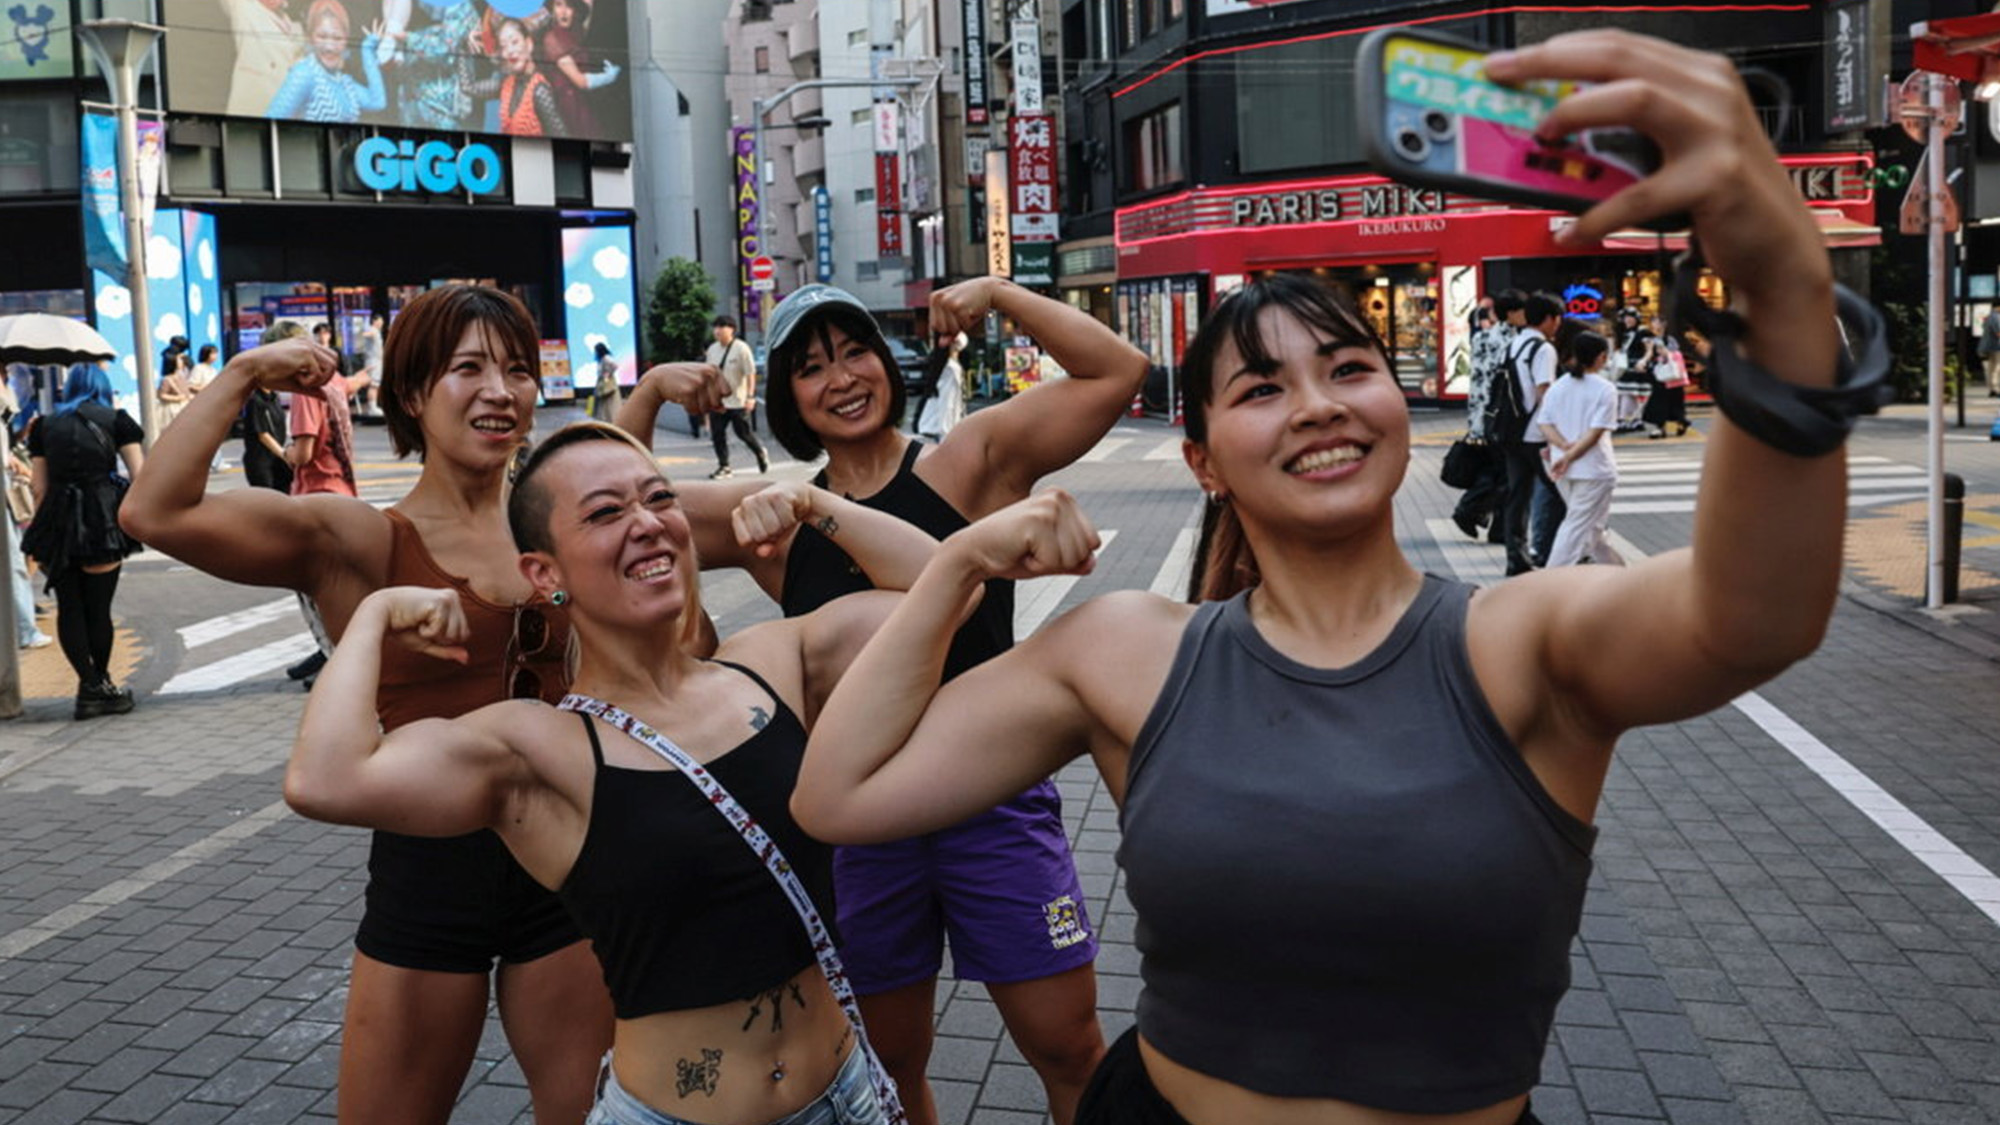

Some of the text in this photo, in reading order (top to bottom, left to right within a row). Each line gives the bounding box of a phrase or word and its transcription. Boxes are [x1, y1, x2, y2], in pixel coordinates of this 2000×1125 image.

[354, 136, 501, 195] GiGO
[1017, 182, 1052, 212] 肉
[1233, 190, 1339, 225] PARIS
[737, 152, 761, 314] NAPOLI
[1358, 218, 1446, 236] IKEBUKURO
